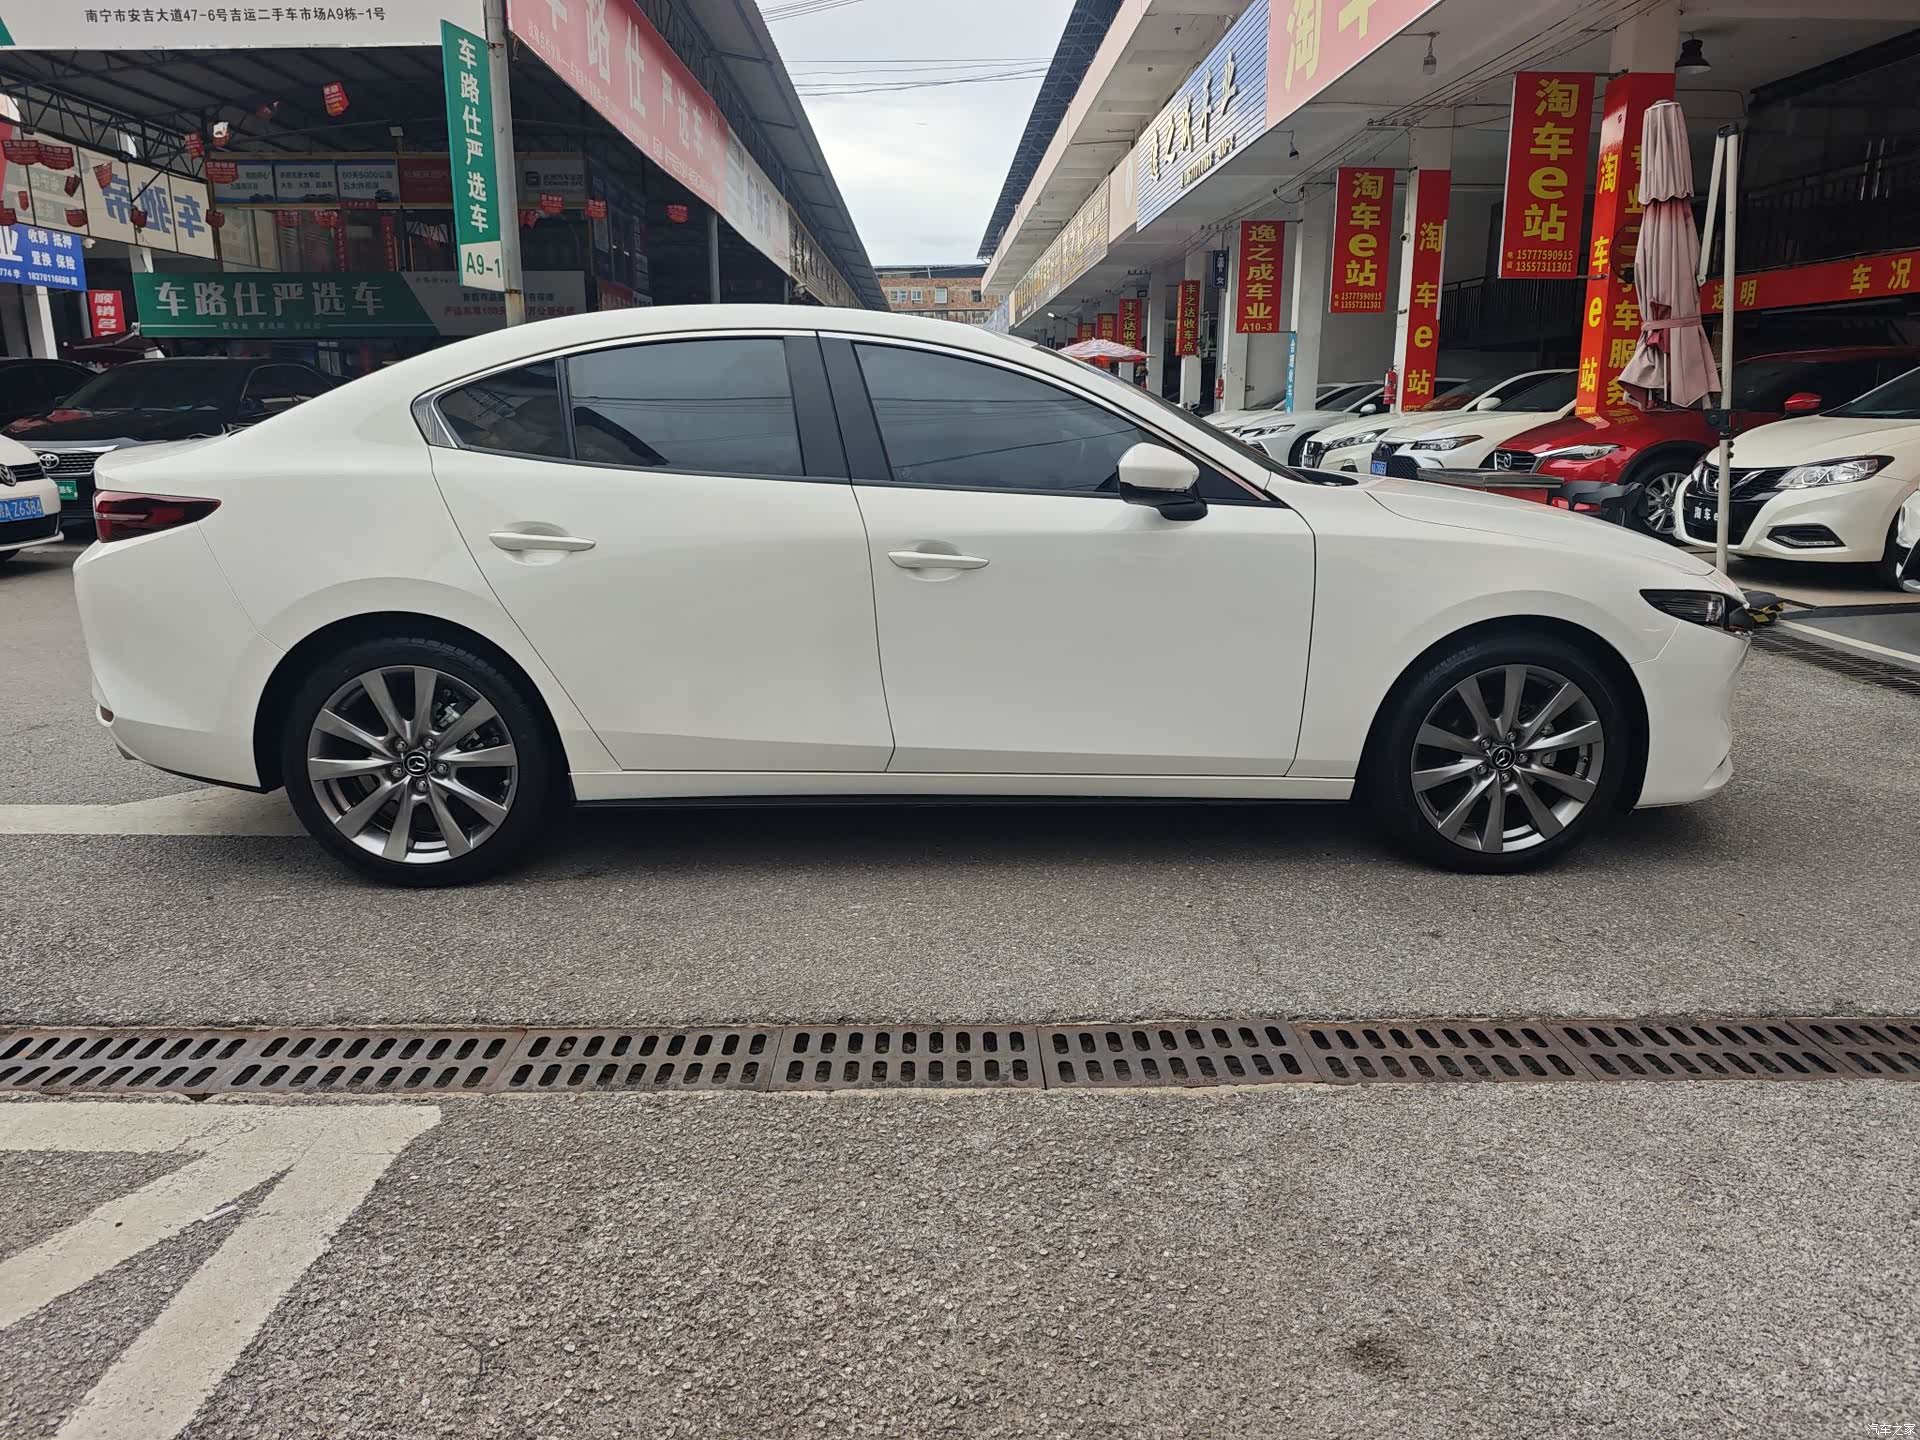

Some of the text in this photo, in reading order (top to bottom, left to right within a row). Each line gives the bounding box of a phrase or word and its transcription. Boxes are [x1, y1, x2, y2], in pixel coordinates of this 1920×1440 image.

[84, 8, 386, 22] 南宁市安吉大道47-6号吉运二手车市场A9栋-1号
[457, 38, 489, 233] 车路仕严选车
[1522, 79, 1580, 241] 淘车e站
[31, 251, 76, 270] 置换 保险
[1345, 172, 1384, 287] 淘车e站
[154, 281, 384, 317] 车路仕严选车
[466, 252, 501, 278] A9-1
[1244, 224, 1278, 319] 逸之成车业
[1579, 151, 1618, 393] 淘车e站
[1849, 258, 1912, 294] 车况
[1183, 284, 1198, 352] 丰之达收车点
[1241, 322, 1273, 331] A10-3
[1407, 222, 1444, 396] 淘车e站
